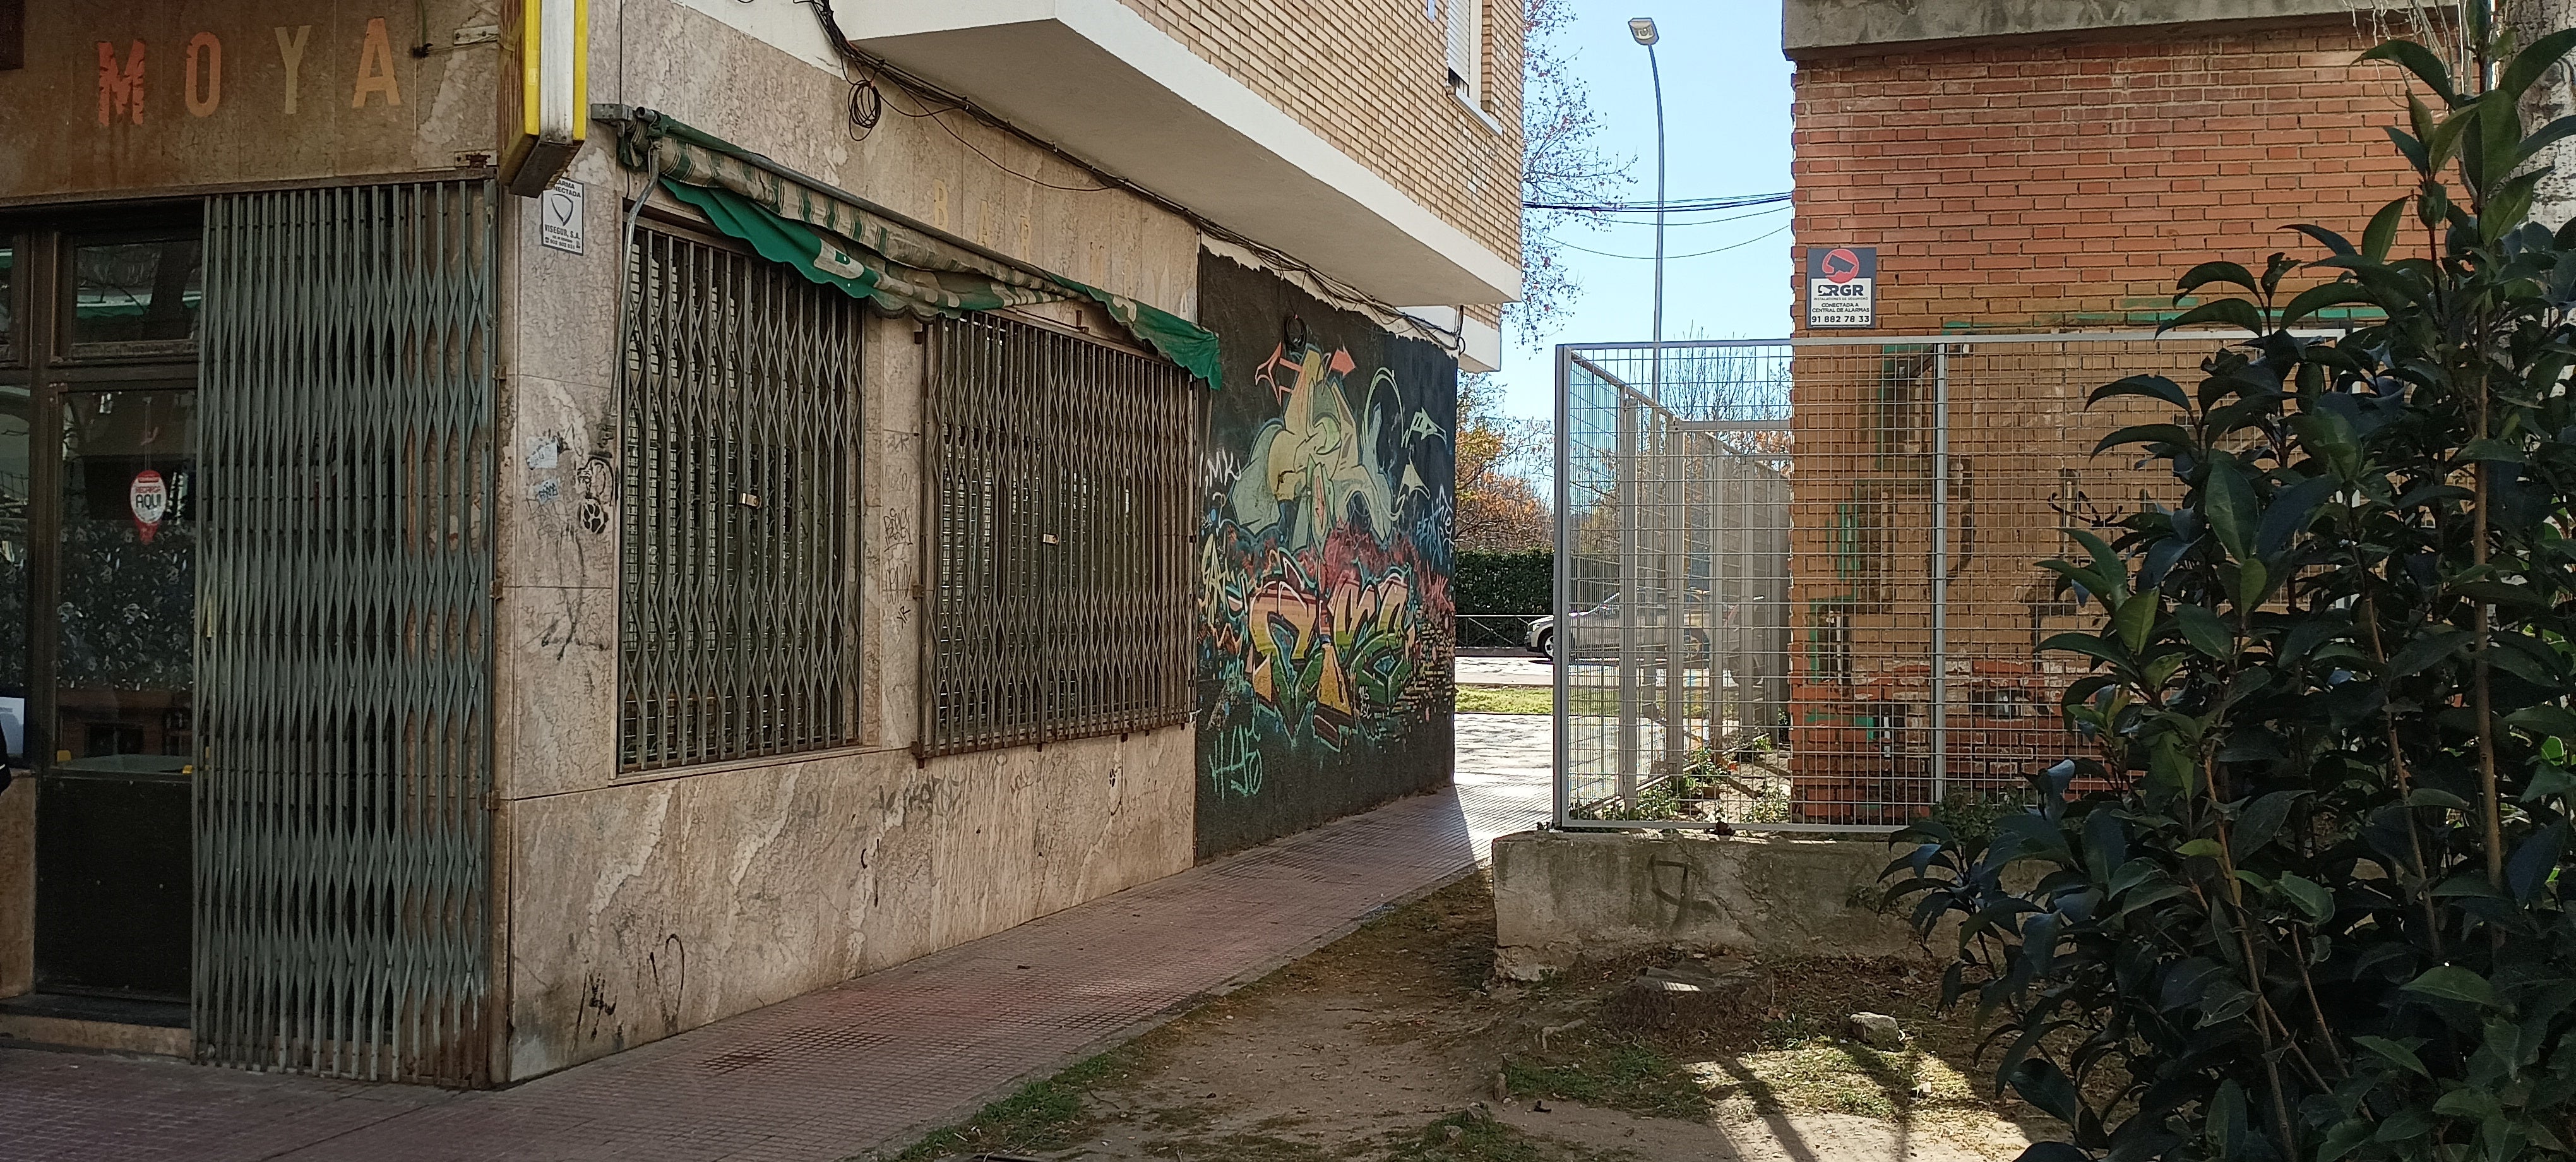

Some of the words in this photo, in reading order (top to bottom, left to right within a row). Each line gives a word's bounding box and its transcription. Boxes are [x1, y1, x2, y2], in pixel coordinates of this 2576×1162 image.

[98, 18, 401, 126] MOYA
[556, 179, 575, 189] ARMA
[553, 186, 581, 198] NECTADA
[934, 179, 1032, 263] BAR
[570, 231, 581, 240] S.A.
